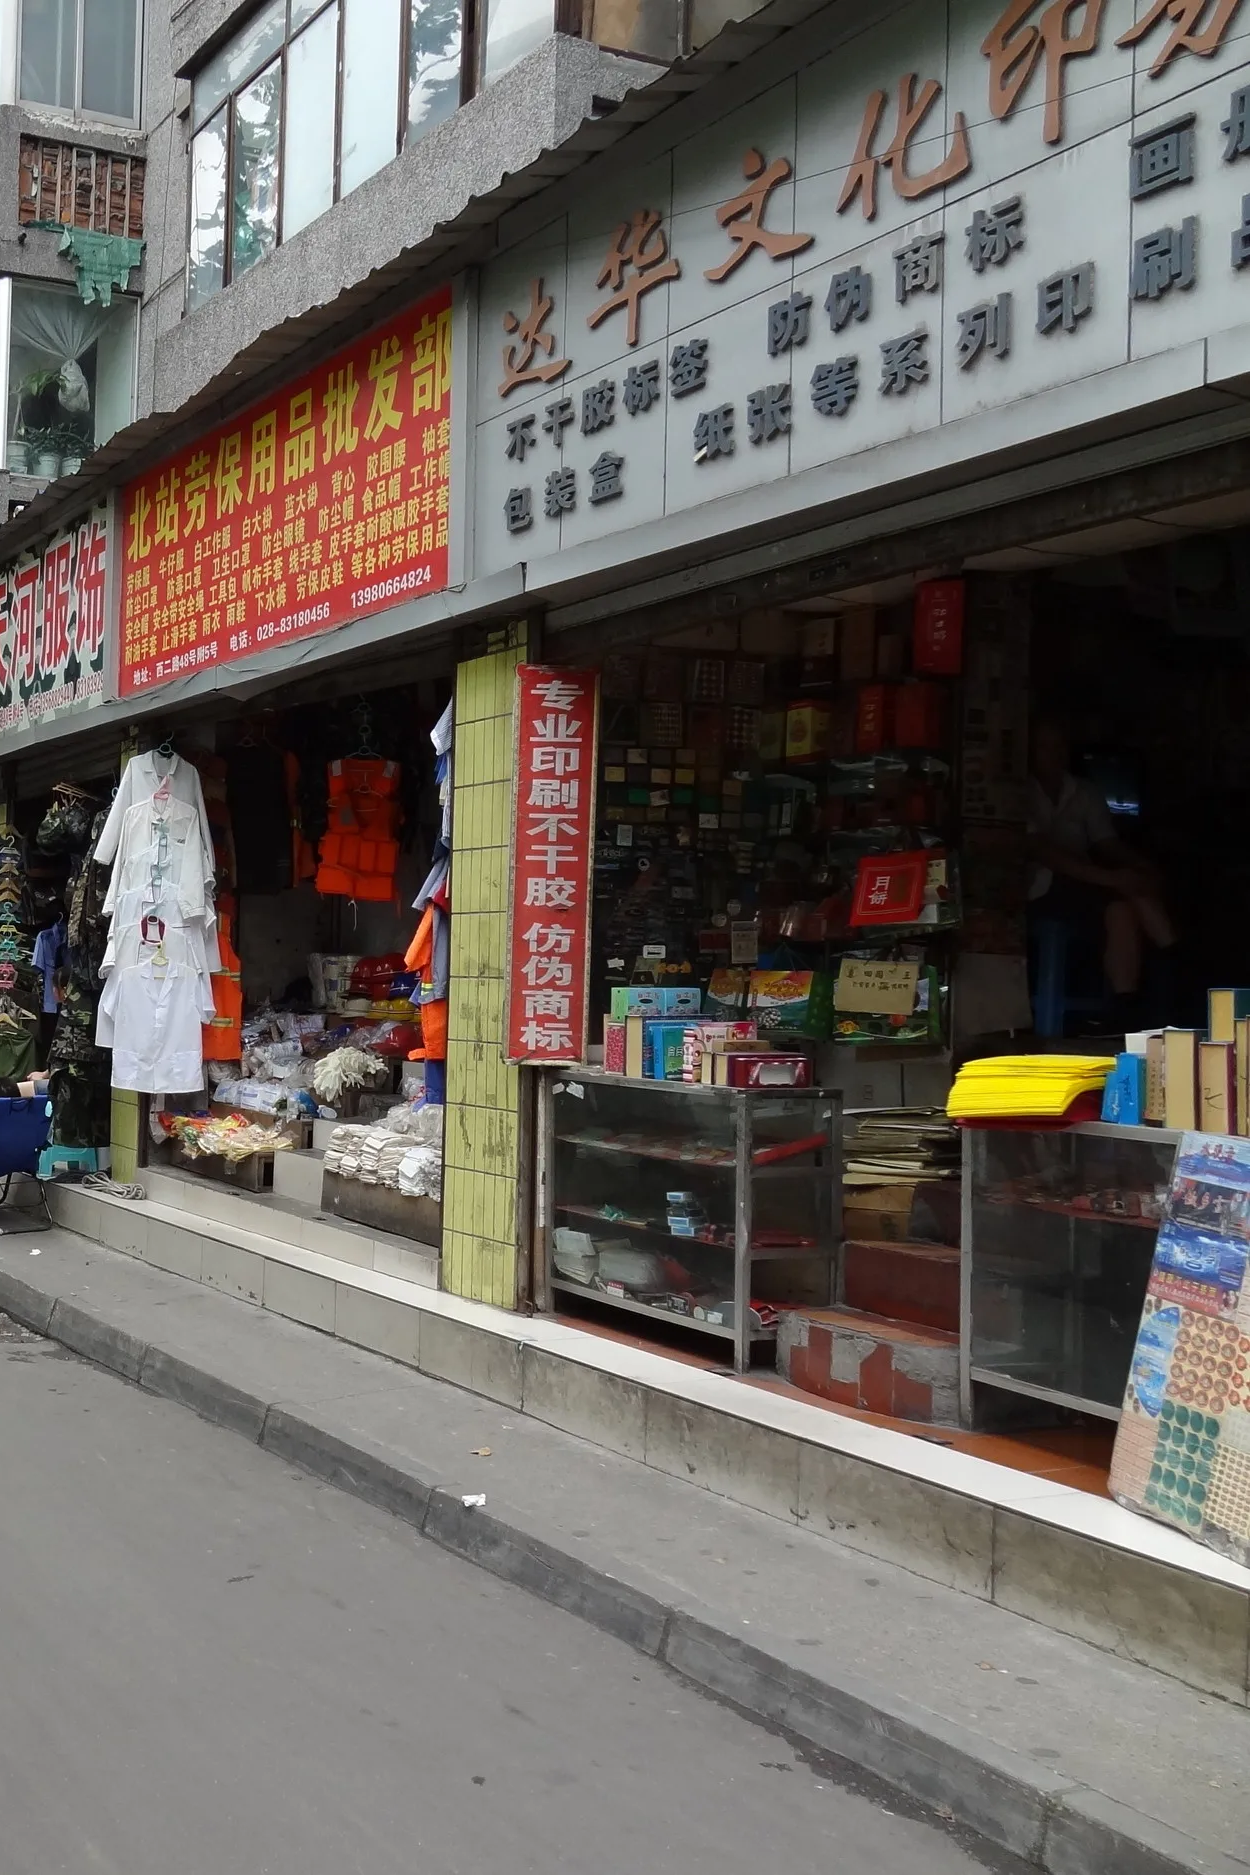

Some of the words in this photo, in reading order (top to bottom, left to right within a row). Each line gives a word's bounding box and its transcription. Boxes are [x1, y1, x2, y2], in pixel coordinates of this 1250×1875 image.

[505, 338, 709, 463] 不干胶标签
[767, 196, 1024, 357] 防伪商标
[127, 307, 452, 563] 北站劳保用品批发部
[503, 451, 625, 533] 包装盒
[350, 565, 431, 608] 13980664824
